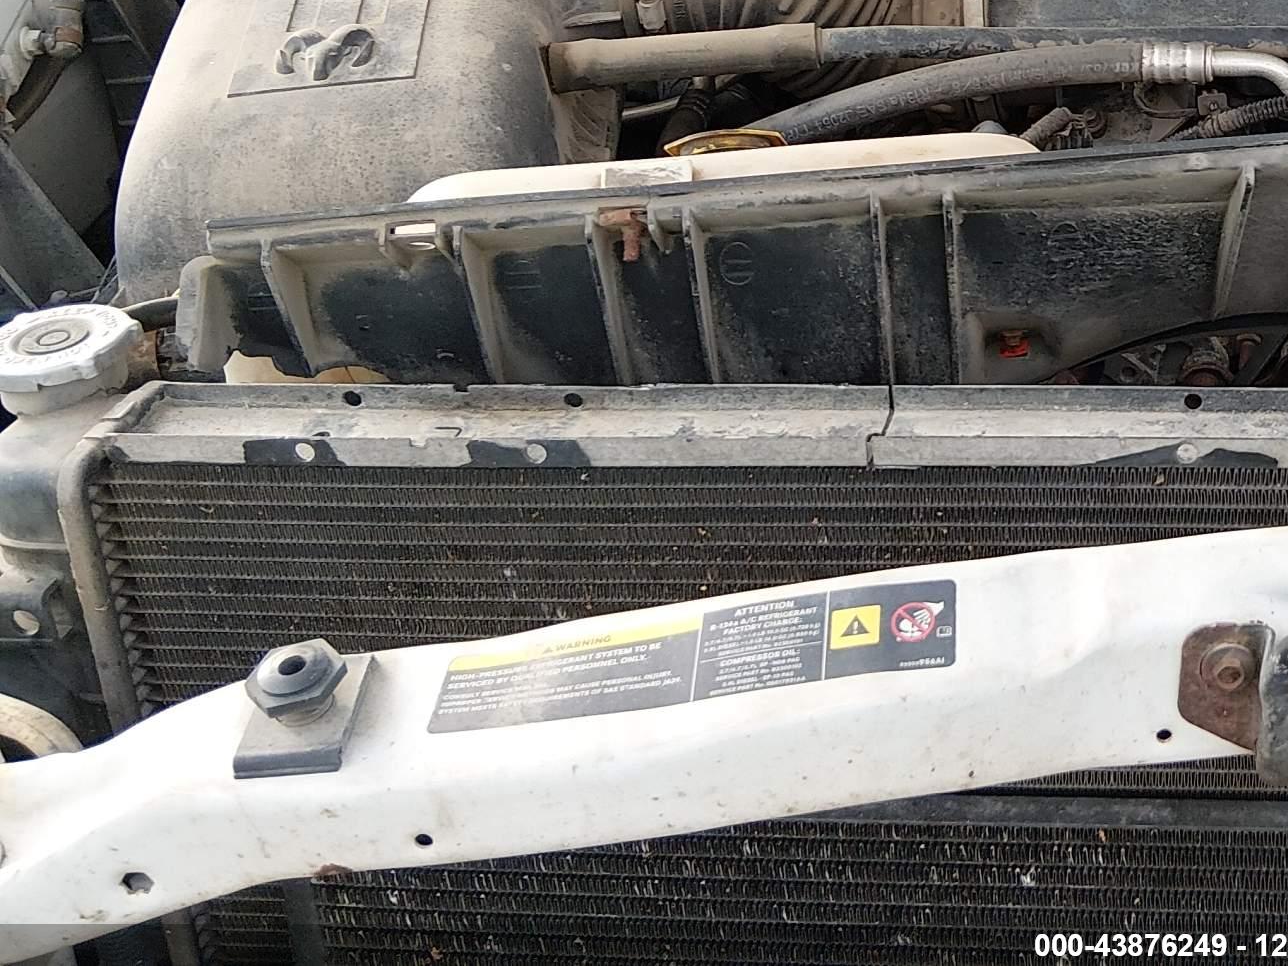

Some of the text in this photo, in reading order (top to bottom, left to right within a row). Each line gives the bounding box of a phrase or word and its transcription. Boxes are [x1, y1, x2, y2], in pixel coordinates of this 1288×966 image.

[734, 599, 796, 618] ATTENTION
[722, 623, 763, 636] FACTORY
[556, 634, 612, 651] WARNING
[594, 646, 633, 660] SYSTEM
[634, 644, 648, 653] TO
[648, 641, 662, 651] BE
[719, 651, 781, 667] COMPRESSOR
[447, 678, 496, 690] SERVICED
